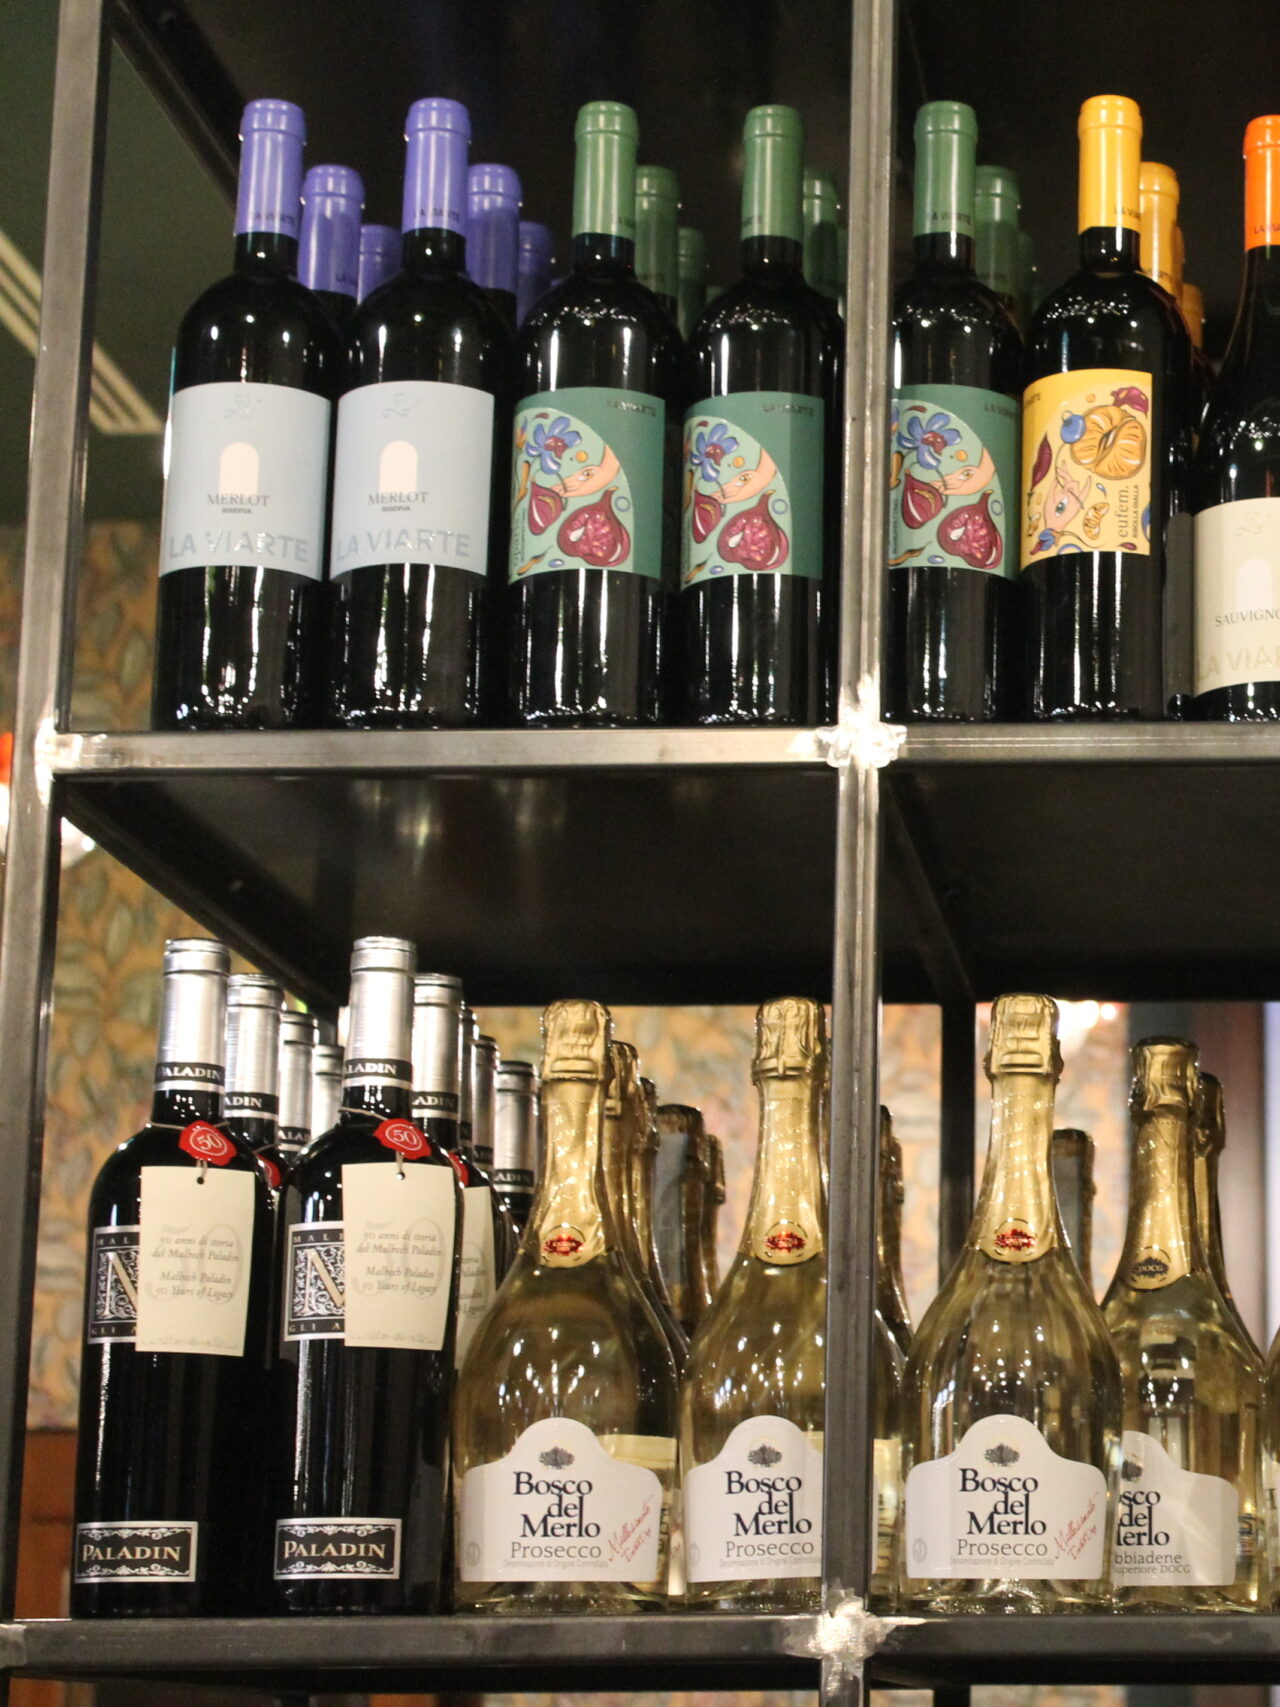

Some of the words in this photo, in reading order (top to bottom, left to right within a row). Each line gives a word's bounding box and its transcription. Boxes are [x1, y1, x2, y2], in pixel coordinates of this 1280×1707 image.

[207, 493, 271, 508] MERLOT
[368, 491, 429, 505] MERLOT
[1114, 485, 1129, 538] eufem.
[169, 533, 196, 560] LA
[204, 530, 310, 563] VIARTE
[335, 536, 360, 561] LA
[364, 528, 471, 557] VIARTE
[1199, 656, 1221, 681] LA
[197, 1134, 221, 1151] 50
[393, 1130, 417, 1146] 50
[513, 1471, 593, 1496] Bosco
[725, 1471, 802, 1495] Bosco
[959, 1468, 1038, 1493] Bosco
[548, 1493, 584, 1518] del
[758, 1491, 794, 1516] del
[993, 1490, 1030, 1515] del
[1119, 1491, 1161, 1506] sco
[520, 1513, 600, 1539] Merlo
[734, 1512, 812, 1537] Merlo
[967, 1510, 1047, 1536] Merlo
[1119, 1504, 1153, 1527] del
[82, 1544, 181, 1562] PALADIN
[284, 1540, 386, 1559] PALADIN
[511, 1541, 602, 1559] Prosecco
[725, 1541, 815, 1558] Prosecco
[957, 1538, 1048, 1557] Prosecco
[1114, 1551, 1183, 1564] bbiadene
[1160, 1564, 1191, 1574] DOCG
